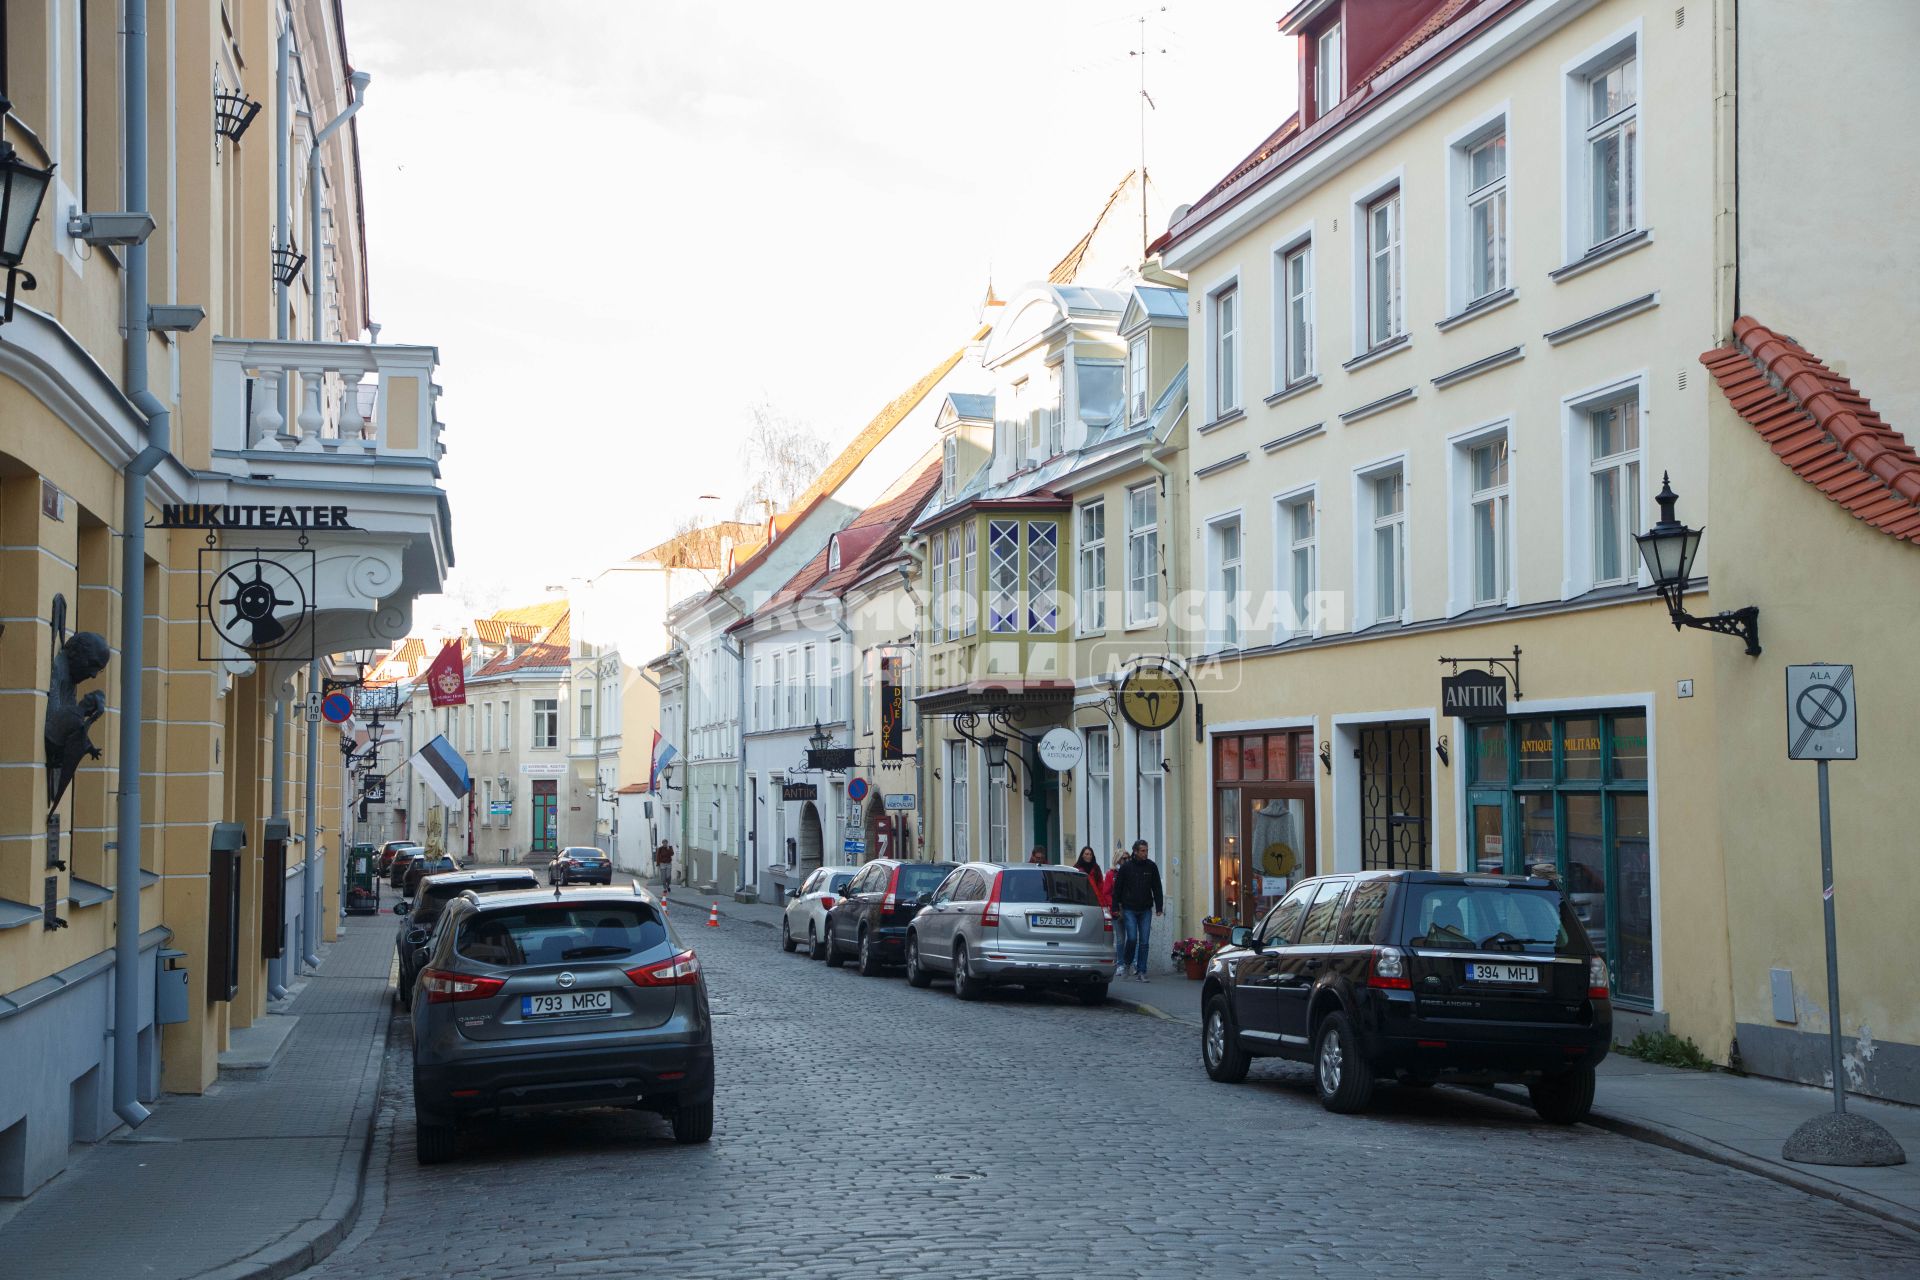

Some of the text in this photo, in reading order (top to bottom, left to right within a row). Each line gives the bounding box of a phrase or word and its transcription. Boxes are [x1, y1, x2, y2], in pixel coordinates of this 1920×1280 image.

[163, 504, 350, 527] NUKUTEATER
[1810, 671, 1831, 680] ALA
[1681, 683, 1687, 695] 4
[1445, 685, 1504, 707] ANTIIK
[309, 705, 319, 714] 10
[1564, 737, 1600, 751] MILITARY
[783, 788, 817, 798] ANTIIK
[1040, 915, 1053, 925] 572
[1477, 965, 1535, 981] 394 MHJ
[535, 993, 606, 1013] 793 MRC
